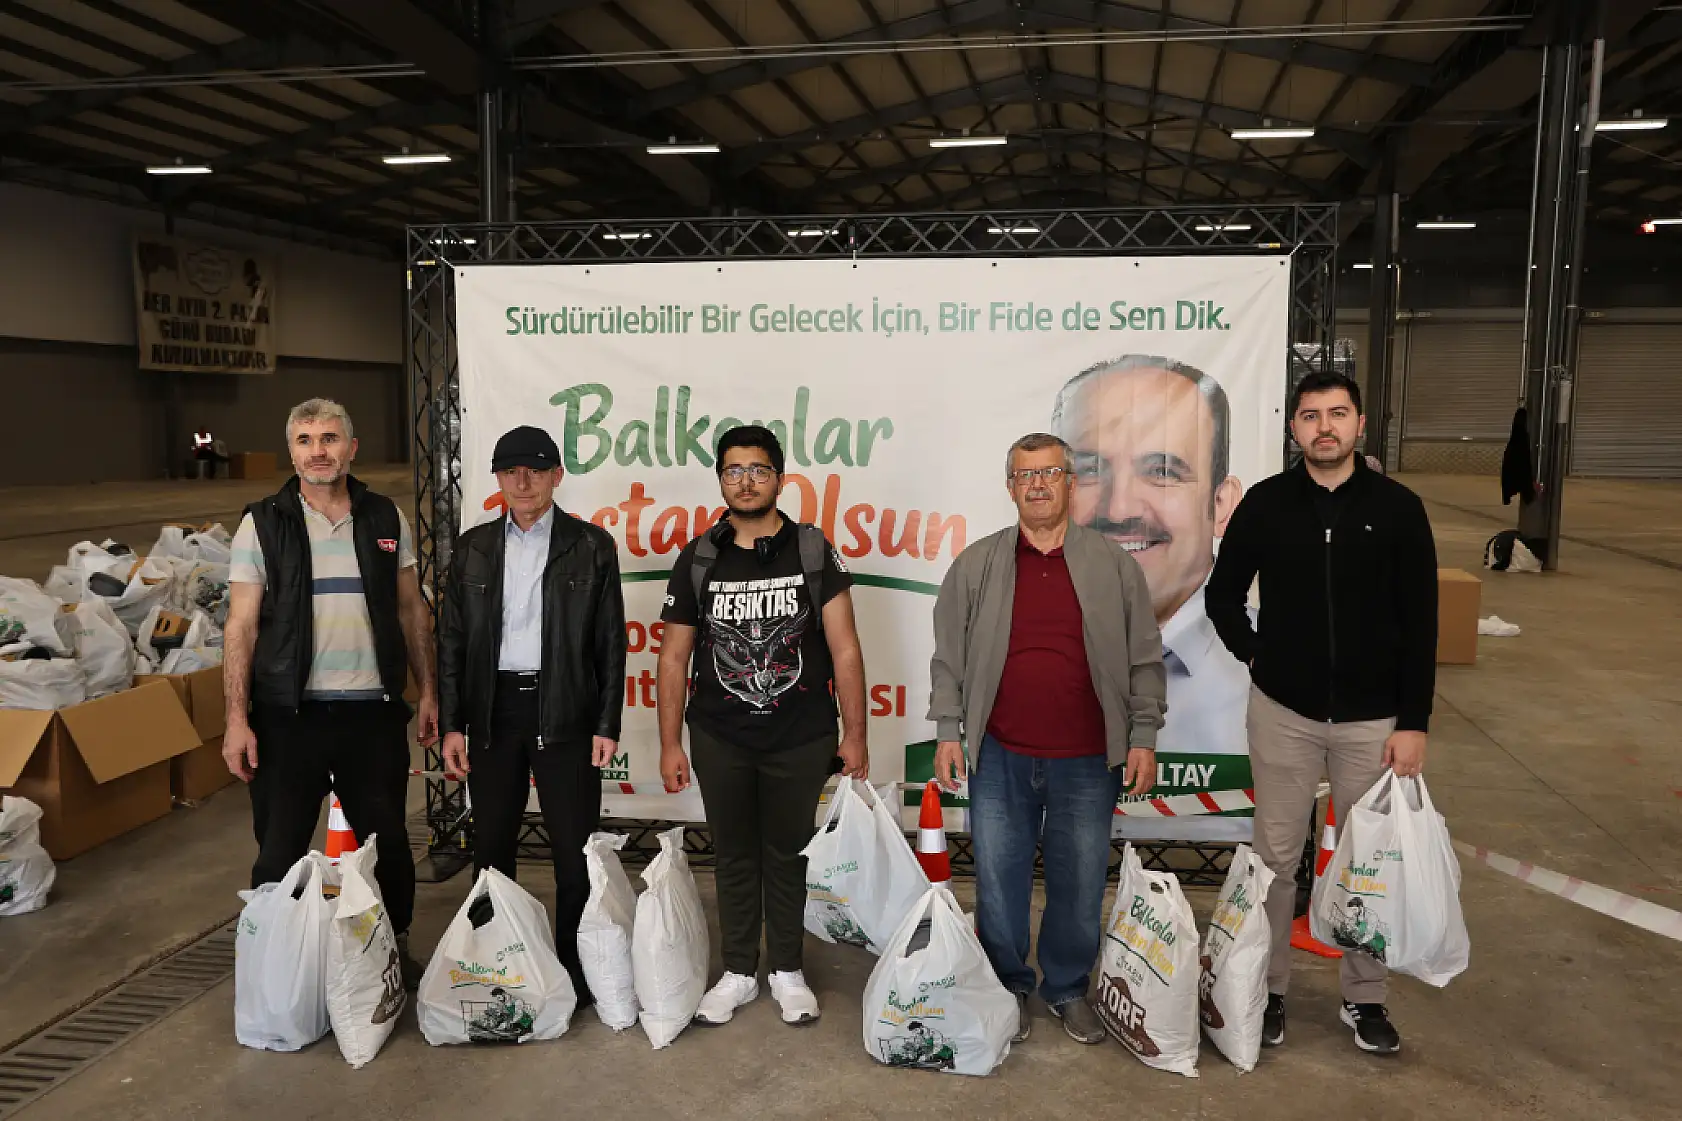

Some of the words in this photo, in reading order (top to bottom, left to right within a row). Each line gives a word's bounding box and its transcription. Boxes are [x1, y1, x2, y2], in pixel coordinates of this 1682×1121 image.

[505, 305, 694, 335] Sürdürülebilir
[702, 304, 741, 333] Bir
[750, 303, 864, 333] Gelecek
[872, 297, 930, 338] İçin,
[939, 301, 982, 332] Bir
[989, 301, 1054, 332] Fide
[1061, 301, 1101, 331] de
[1109, 300, 1166, 331] Sen
[1175, 299, 1232, 330] Dik.
[1155, 762, 1217, 788] LTAY
